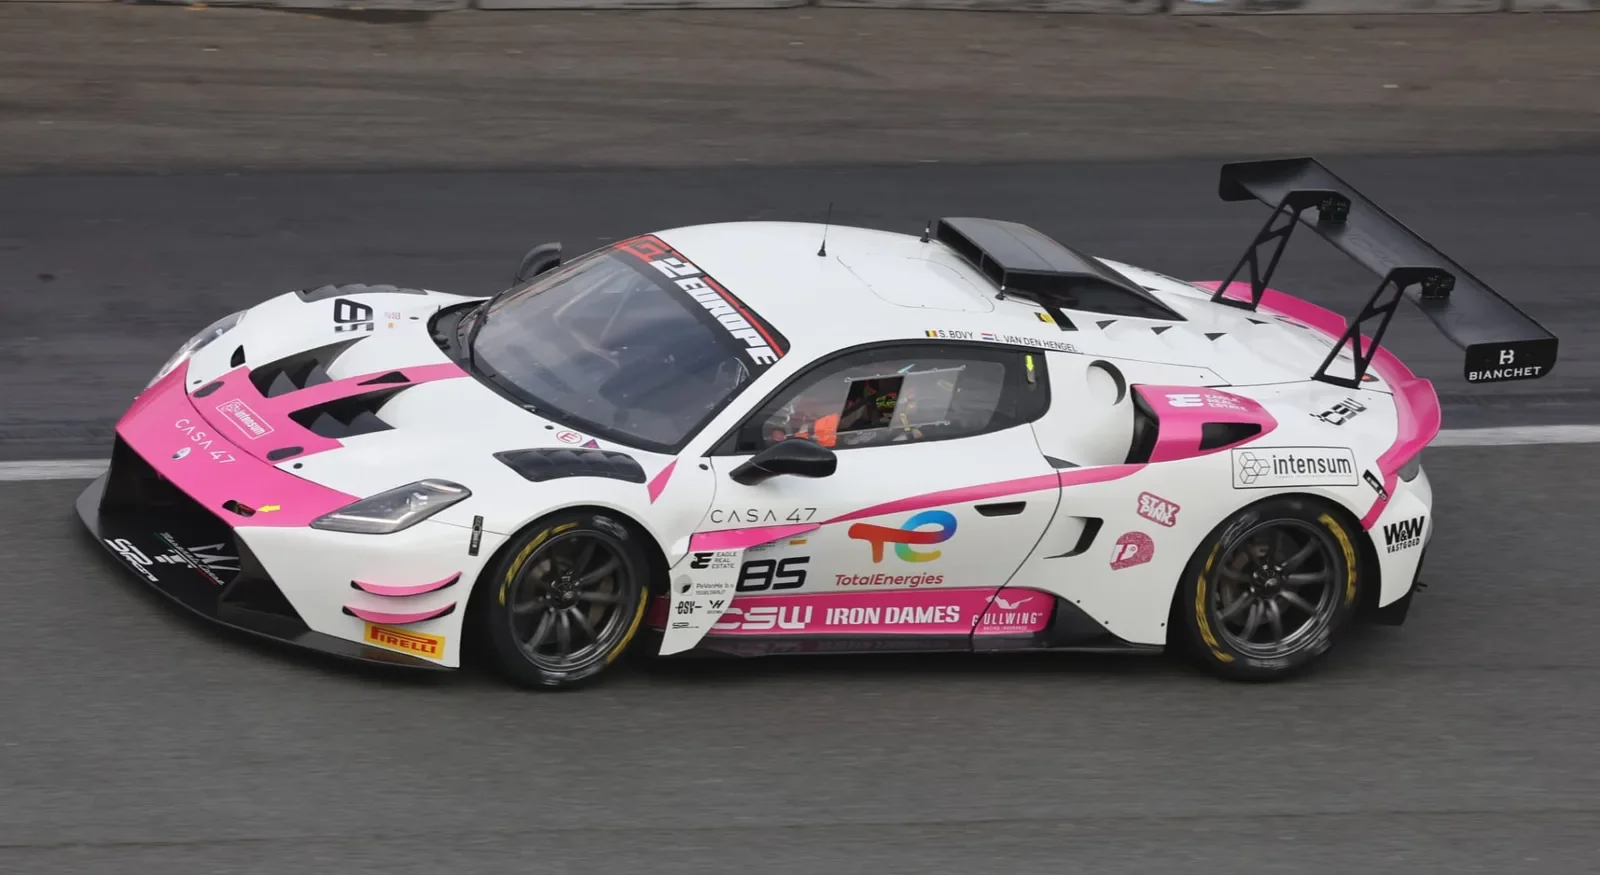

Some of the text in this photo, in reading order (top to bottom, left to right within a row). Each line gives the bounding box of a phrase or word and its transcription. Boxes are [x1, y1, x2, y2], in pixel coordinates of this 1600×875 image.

[674, 277, 779, 366] EUROPE
[938, 329, 973, 340] S. BOVY
[994, 334, 1077, 352] L. VAN DEN HENGEL
[1468, 366, 1542, 381] BIANCHET
[175, 418, 236, 464] CASA 47
[1272, 454, 1352, 475] intensum
[1140, 494, 1177, 516] STAY
[710, 507, 818, 524] CASA 47
[1383, 515, 1425, 546] W&W
[1386, 538, 1421, 554] VASTGOED
[735, 556, 811, 593] 85
[835, 572, 944, 588] TotalEnergies
[825, 605, 960, 625] IRON DAMES
[971, 612, 1037, 627] GULLWING
[370, 626, 438, 654] PIRELLI
